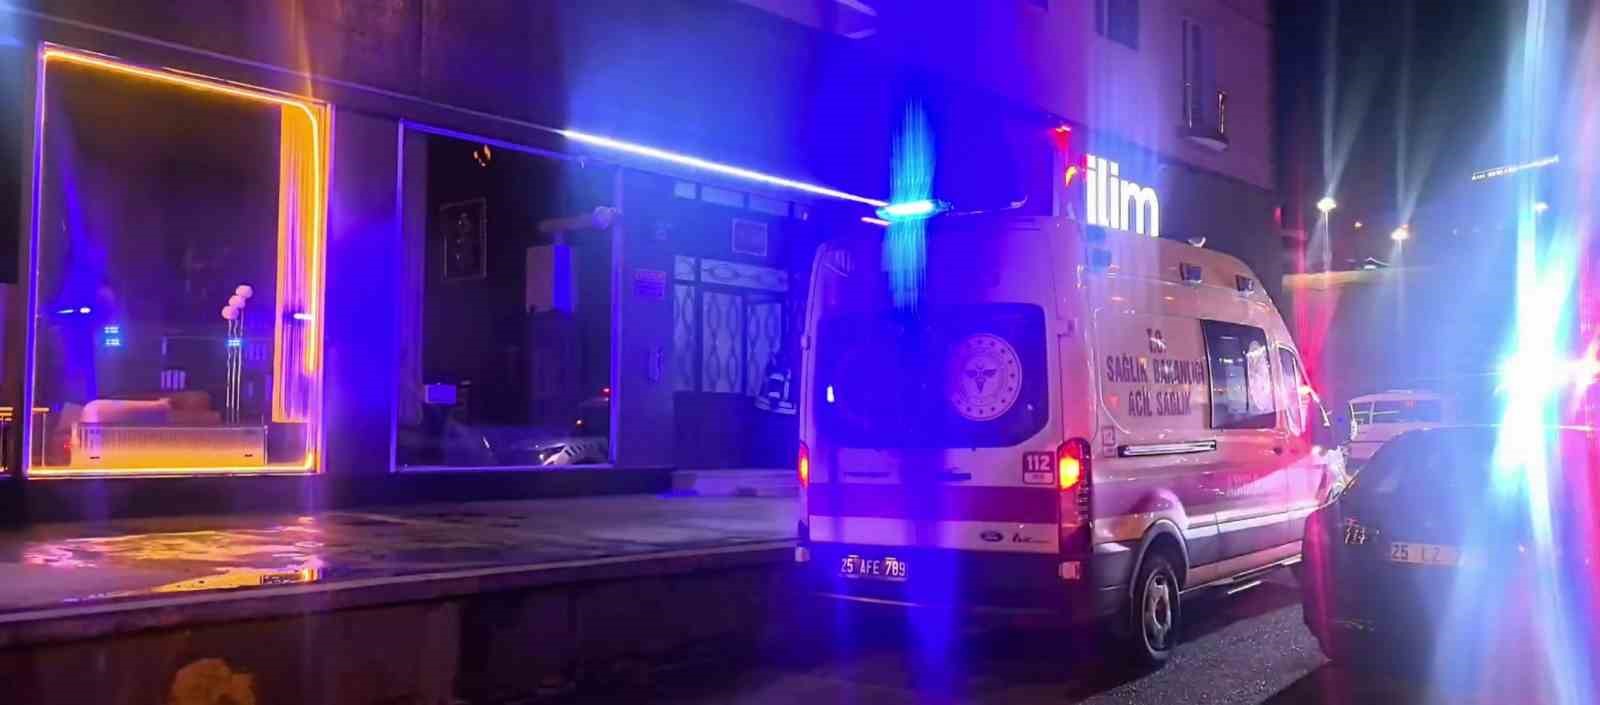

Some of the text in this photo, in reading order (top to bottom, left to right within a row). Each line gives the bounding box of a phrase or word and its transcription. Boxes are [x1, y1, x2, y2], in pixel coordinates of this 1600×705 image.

[1106, 353, 1148, 383] SAĞLIK
[1027, 455, 1050, 470] 112
[1391, 543, 1409, 561] 25
[841, 558, 906, 576] 25 AFE 789
